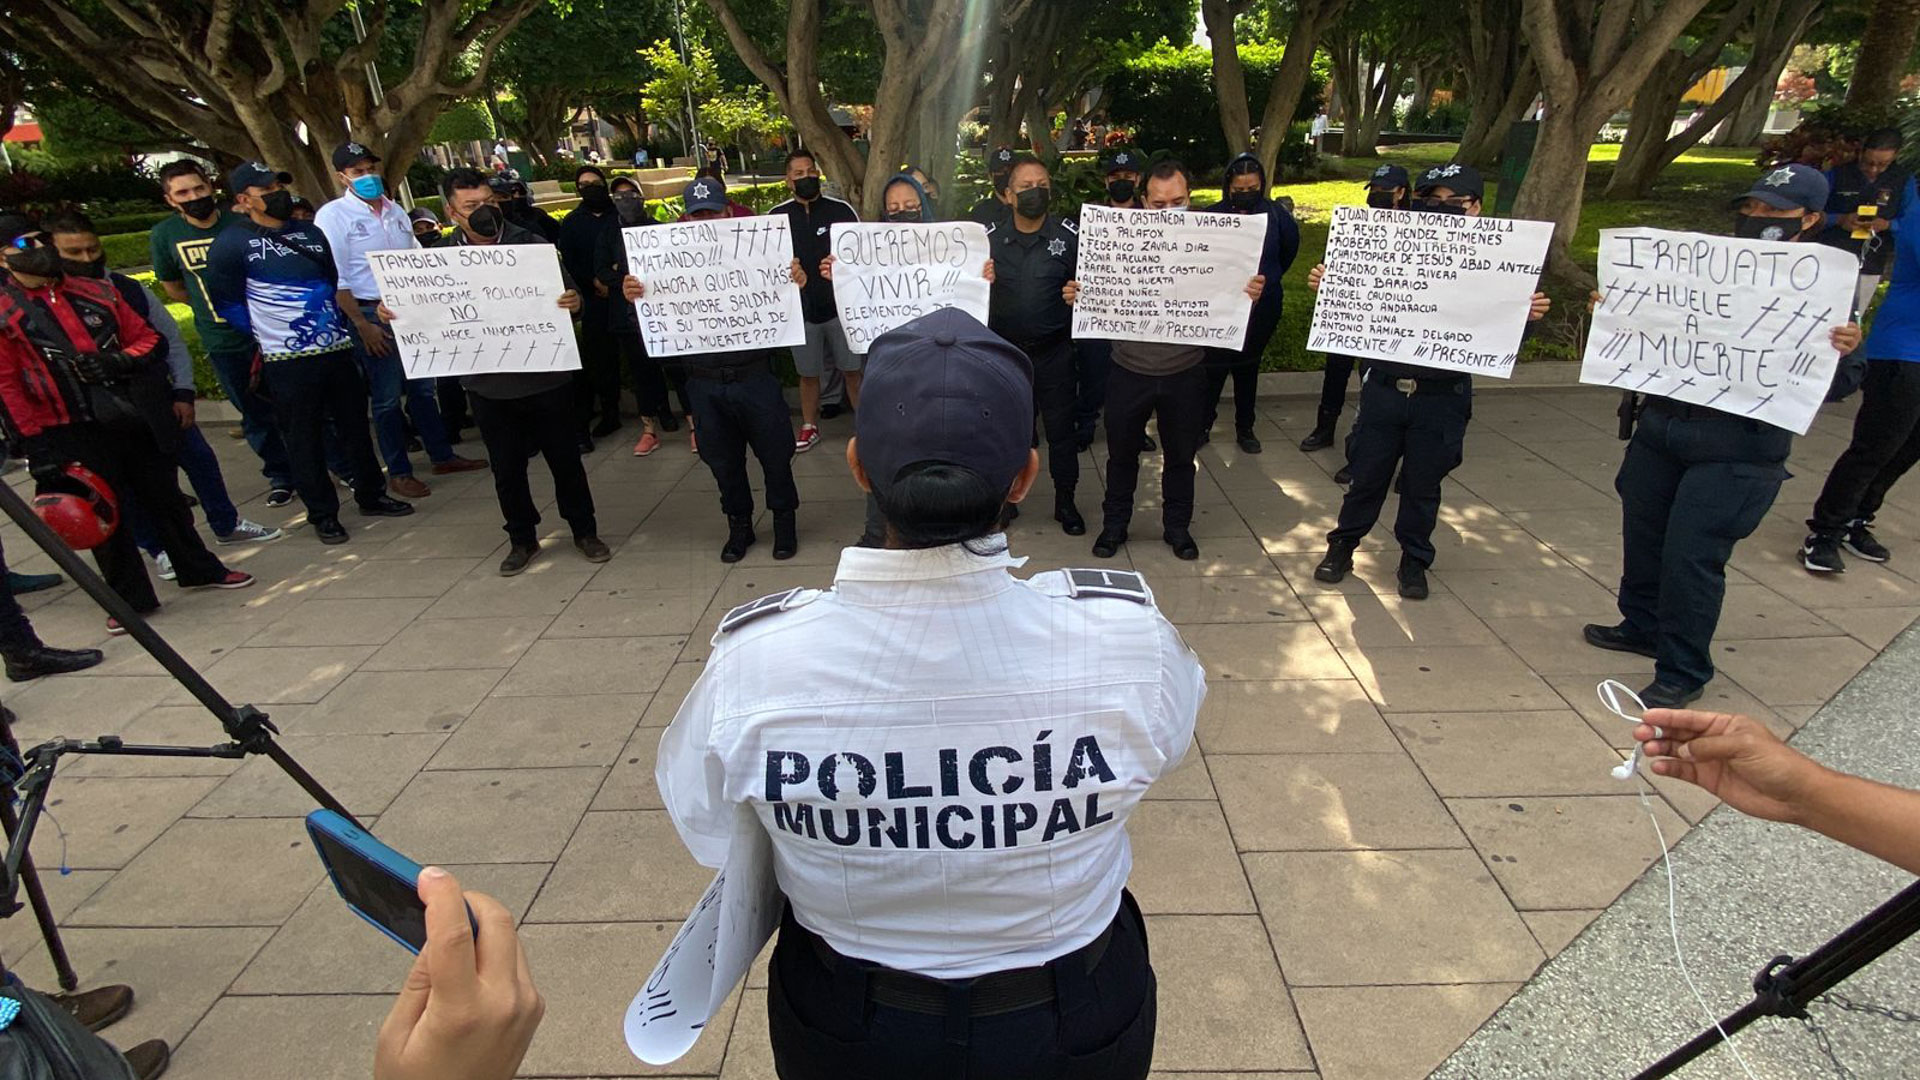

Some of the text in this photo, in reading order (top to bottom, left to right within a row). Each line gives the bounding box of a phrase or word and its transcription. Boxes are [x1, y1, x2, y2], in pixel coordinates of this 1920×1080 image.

[1087, 207, 1126, 224] JAVIER
[1129, 210, 1185, 226] CASTAÑEDA
[1338, 206, 1513, 233] JUAN CARLOS MORENO AYALA
[625, 224, 718, 251] NOS ESTAN
[1088, 226, 1164, 239] LUIS PALAFOX
[1353, 223, 1388, 239] REYES
[1446, 231, 1502, 246] JIMENES
[837, 227, 968, 268] QUEREMOS
[1087, 239, 1210, 253] FEDERICO ZAVALA DIAZ
[1334, 236, 1477, 257] ROBERTO CONTRERAS
[373, 250, 516, 271] TAMBIEN SOMOS
[631, 245, 723, 274] MATANDO!!!
[1085, 251, 1160, 264] SONIA ARELLANO
[1331, 248, 1396, 263] CHRISTOPHER
[1401, 252, 1413, 265] DE
[1416, 252, 1453, 267] JESÚS
[1459, 257, 1491, 271] ABAD
[1611, 236, 1820, 291] IRAPUATO
[1084, 262, 1214, 275] RAFAEL NEGRETE CASTILLO
[1416, 267, 1457, 280] RIVERA
[385, 275, 468, 290] HUMANOS...
[652, 275, 699, 296] AHORA
[704, 269, 749, 292] QUIEN
[1138, 276, 1174, 285] HUERTA
[1373, 277, 1429, 290] BARRIOS
[386, 286, 545, 307] EL UNIFORME POLICIAL
[1082, 286, 1161, 297] GABRIELA NUÑEZ
[1326, 287, 1413, 303] MIGUEL CAUDILLO
[1656, 284, 1732, 318] HUELE
[450, 304, 479, 320] NO
[641, 291, 781, 318] QUE NOMBRE SALDRA
[845, 304, 922, 321] ELEMENTOS
[1164, 299, 1209, 309] BAUTISTA
[1166, 309, 1209, 318] MENDOZA
[1323, 299, 1438, 313] FRANCISCO ANDARACUA
[648, 312, 788, 334] EN SU TOMBOLA DE
[1321, 309, 1397, 324] GUSTAVO LUNA
[1686, 314, 1699, 335] A
[401, 332, 429, 345] NOS
[442, 329, 475, 341] HACE
[674, 328, 778, 351] LA MUERTE???
[1320, 320, 1473, 342] ANTONIO RAMIREZ DELGADO
[765, 729, 1118, 802] POLICÍA
[773, 793, 1114, 850] MUNICIPAL
